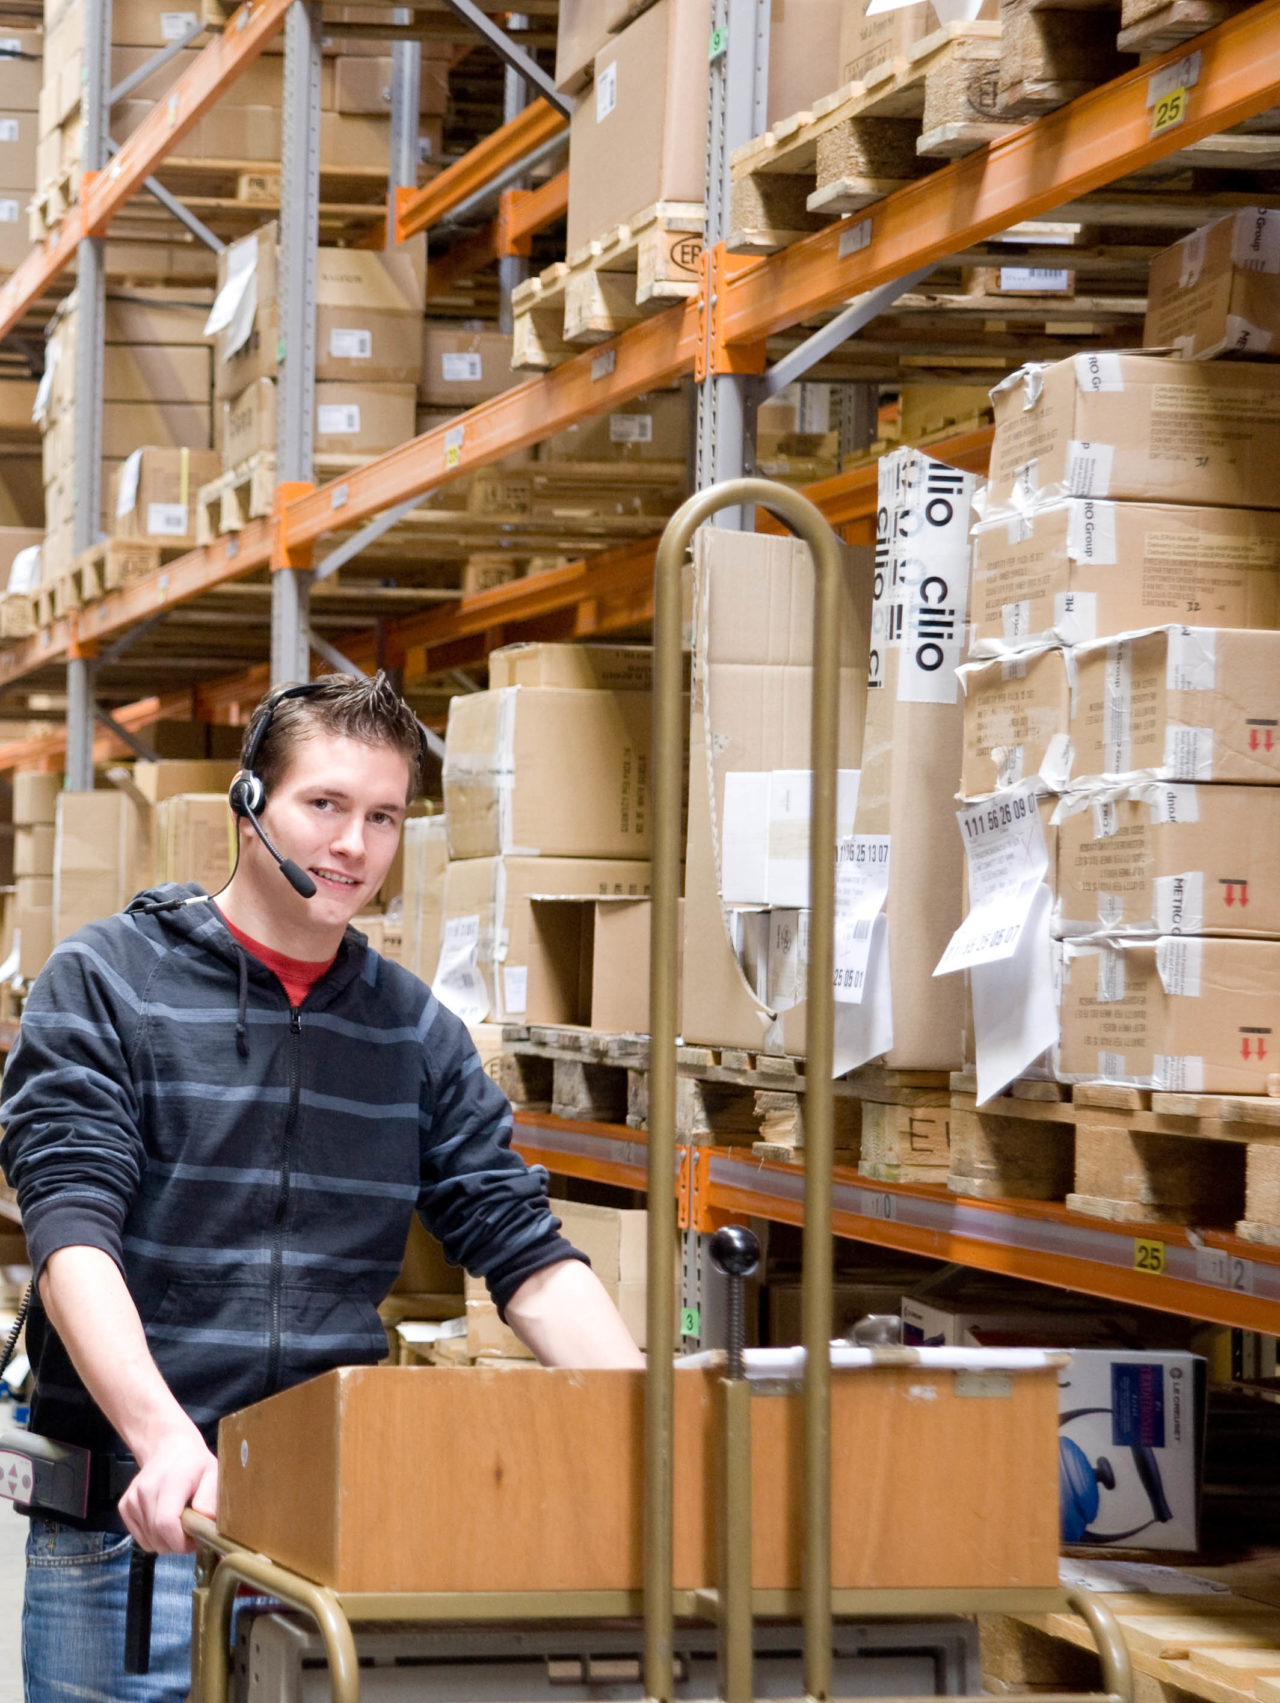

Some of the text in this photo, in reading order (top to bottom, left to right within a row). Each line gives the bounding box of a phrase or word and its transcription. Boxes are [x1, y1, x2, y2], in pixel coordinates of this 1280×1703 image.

[1156, 96, 1181, 128] 25
[1250, 217, 1267, 252] Group
[874, 506, 890, 600] cilio
[1084, 522, 1095, 557] Group
[915, 576, 955, 671] cilio
[965, 816, 985, 838] 111
[988, 810, 999, 830] 56
[1000, 803, 1012, 826] 26
[1013, 798, 1026, 820] 09
[856, 844, 866, 862] 25
[869, 844, 877, 863] 13
[878, 845, 888, 863] 07
[1172, 878, 1183, 924] METRO
[834, 968, 843, 986] 25
[1137, 1245, 1162, 1271] 25
[686, 1313, 694, 1331] 3
